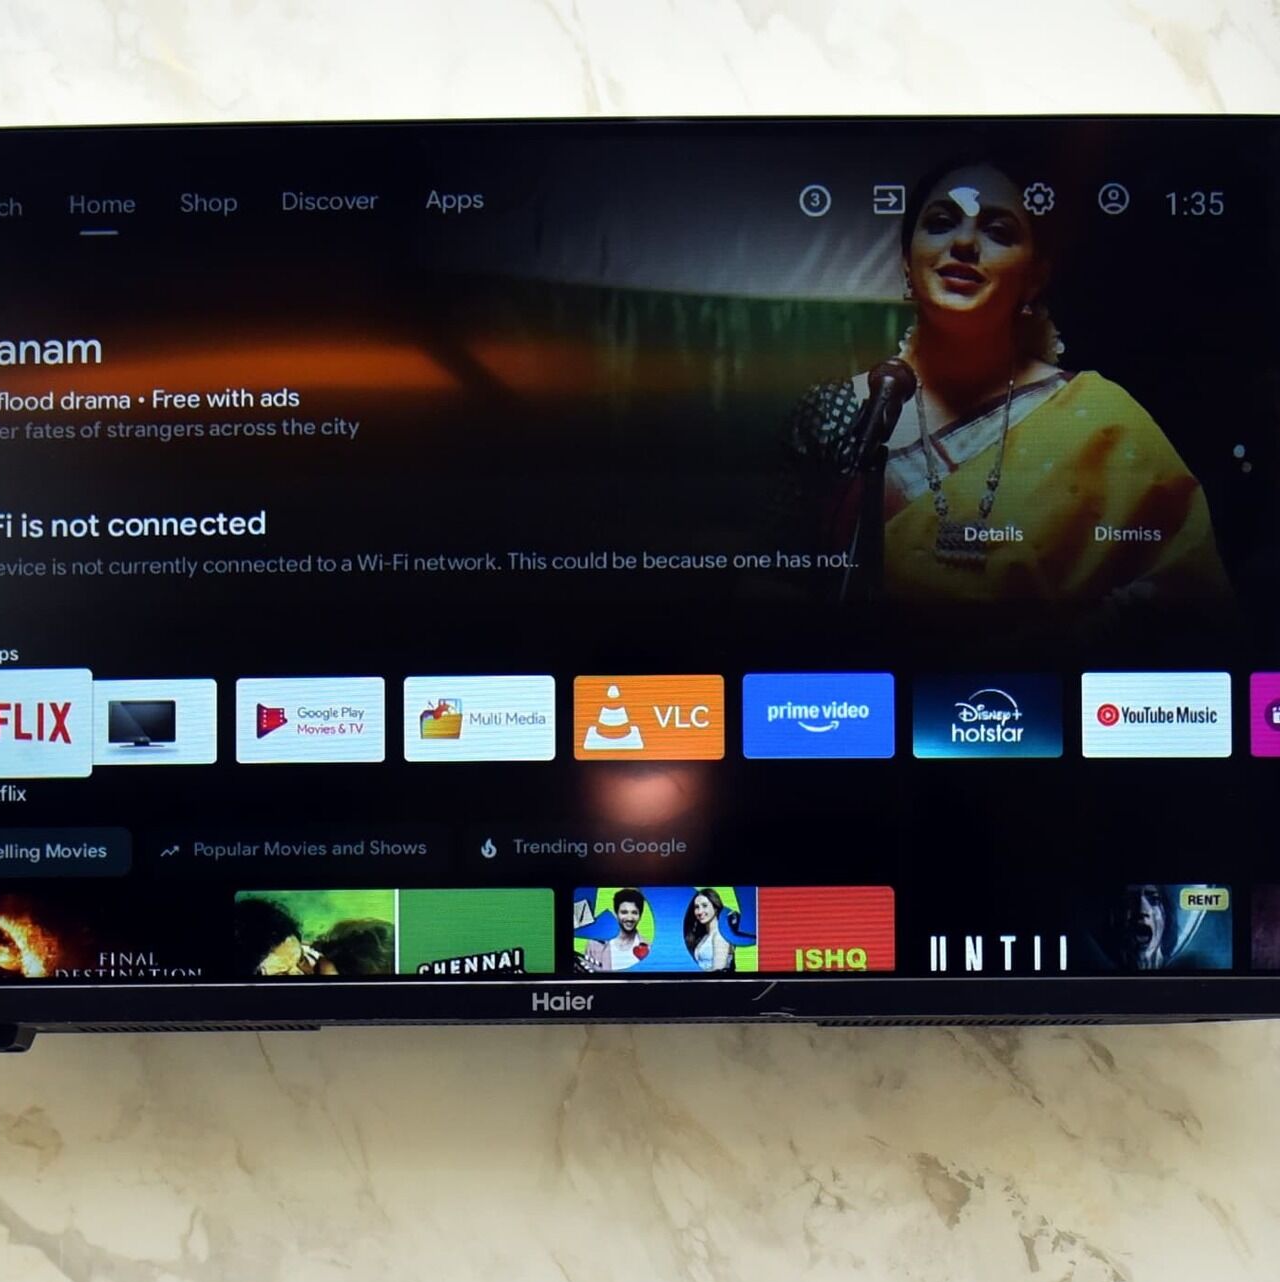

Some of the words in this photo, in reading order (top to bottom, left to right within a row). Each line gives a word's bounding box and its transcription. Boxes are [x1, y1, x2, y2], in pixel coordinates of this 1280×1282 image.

[69, 195, 136, 214] Home
[180, 192, 238, 217] Shop
[282, 191, 379, 211] Discover
[425, 189, 485, 214] Apps
[810, 192, 821, 207] 3
[1165, 191, 1224, 216] 1:35
[60, 390, 131, 410] drama
[152, 389, 201, 409] Free
[206, 388, 254, 408] with
[260, 387, 300, 408] ads
[24, 421, 76, 439] fates
[79, 420, 102, 439] of
[106, 421, 205, 442] strangers
[208, 422, 277, 437] across
[281, 417, 316, 436] the
[320, 417, 360, 440] city
[21, 512, 44, 538] is
[51, 514, 100, 538] not
[107, 510, 266, 537] connected
[964, 525, 1024, 542] Details
[1094, 525, 1162, 542] Dismiss
[52, 558, 67, 576] is
[71, 559, 104, 575] not
[108, 556, 198, 579] currently
[202, 554, 312, 574] connected
[316, 555, 337, 572] to
[340, 558, 353, 572] a
[357, 553, 409, 572] Wi-Fi
[414, 552, 502, 571] network.
[507, 551, 548, 570] This
[551, 551, 608, 570] could
[612, 551, 638, 569] be
[642, 551, 728, 569] because
[732, 554, 772, 569] one
[776, 550, 812, 569] has
[296, 706, 339, 721] Google
[340, 706, 365, 721] Play
[469, 712, 502, 726] Multi
[505, 711, 547, 726] Media
[653, 705, 710, 728] VLC
[767, 701, 819, 722] prime
[821, 701, 870, 719] video
[1121, 706, 1174, 724] YouTube
[1176, 706, 1218, 724] Music
[296, 723, 336, 735] Movies
[337, 723, 347, 735] &
[348, 723, 364, 734] TV
[951, 723, 1024, 742] hotstar
[45, 843, 108, 859] Movies
[193, 841, 260, 861] Popular
[264, 840, 328, 856] Movies
[331, 840, 365, 856] and
[369, 839, 427, 856] Shows
[513, 838, 588, 858] Trending
[593, 841, 616, 854] on
[620, 837, 687, 857] Google
[1187, 894, 1221, 906] RENT
[99, 951, 158, 967] FINAL
[795, 948, 867, 971] ISHQ
[532, 990, 594, 1012] Haier
